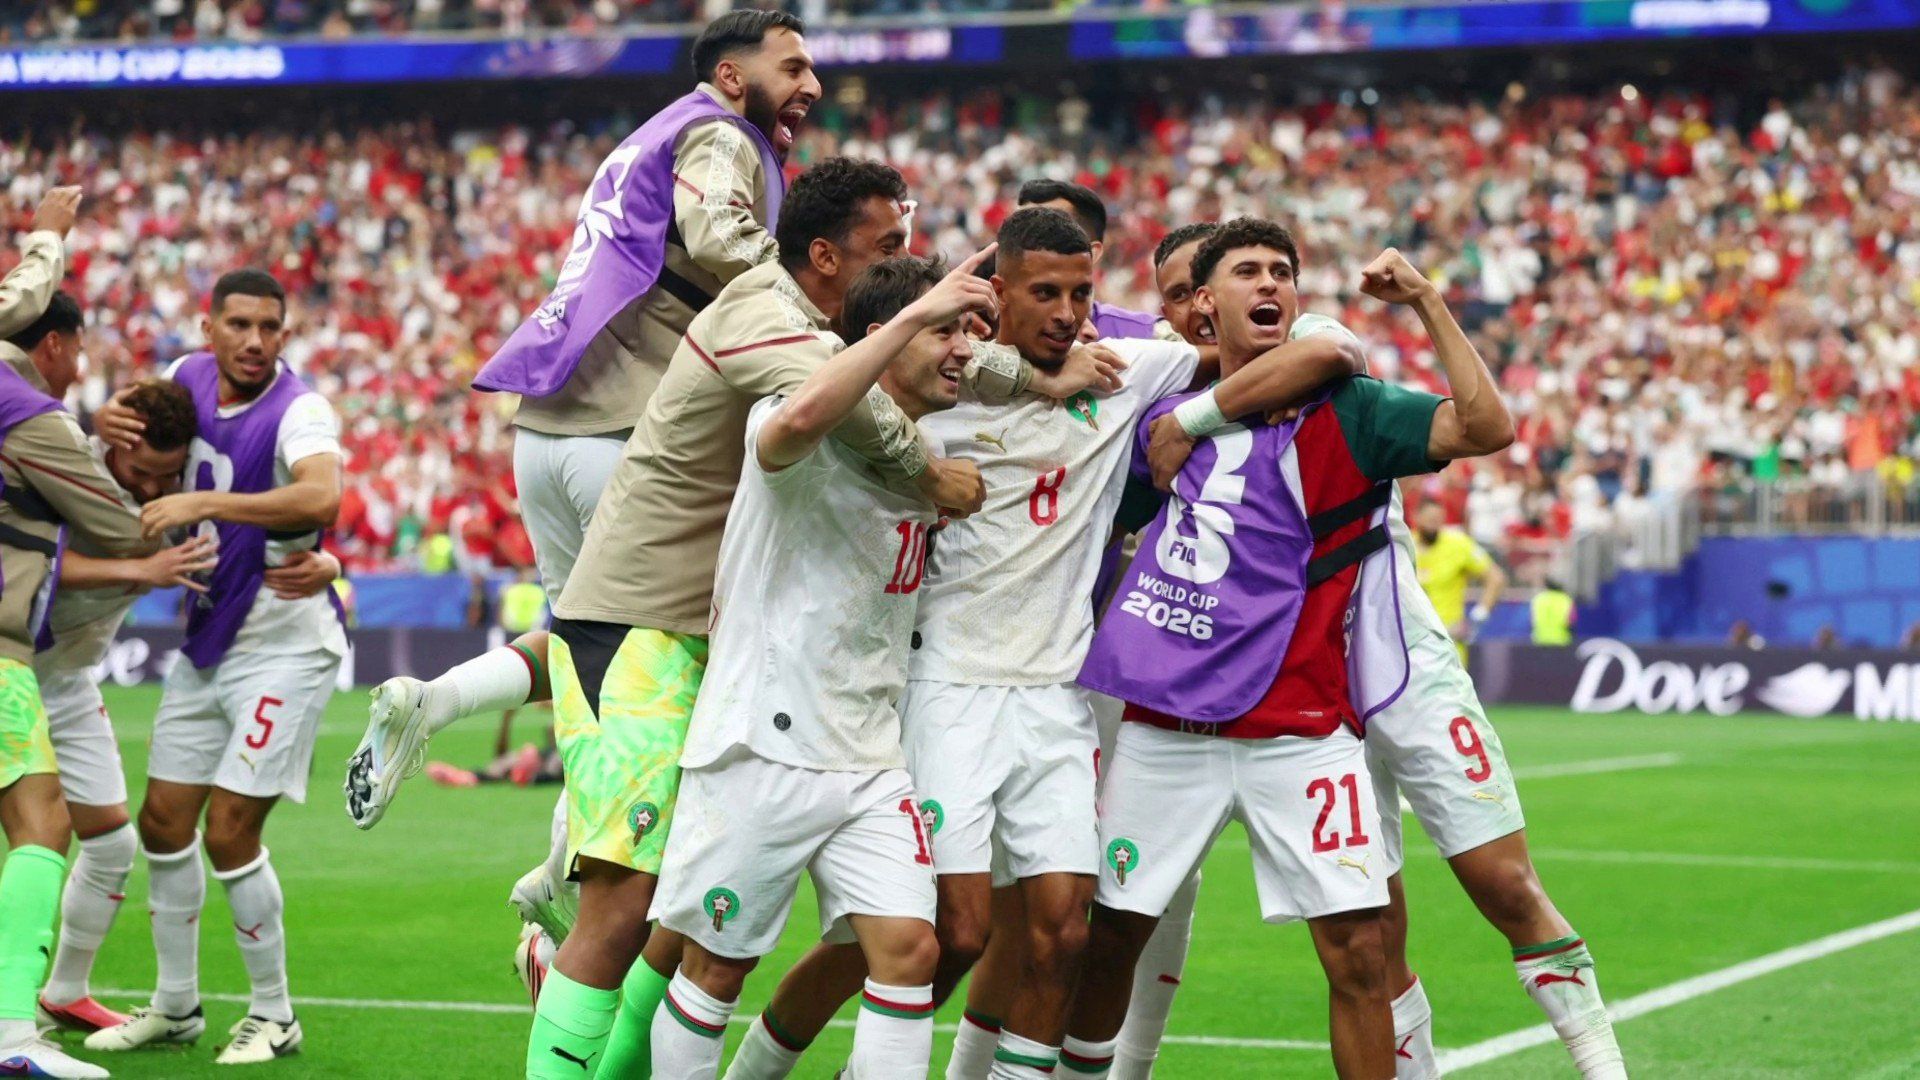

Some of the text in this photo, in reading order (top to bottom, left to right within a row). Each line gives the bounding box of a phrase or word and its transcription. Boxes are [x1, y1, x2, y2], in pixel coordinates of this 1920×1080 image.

[20, 50, 119, 84] WORLD
[123, 49, 181, 81] CUP
[181, 46, 285, 80] 2026
[1029, 464, 1067, 526] 8
[883, 520, 927, 594] 10
[1120, 591, 1213, 640] 2026
[1137, 571, 1219, 611] WORLD CUP
[1570, 637, 1750, 716] Dove
[245, 695, 284, 751] 5
[1448, 715, 1493, 783] 9
[898, 798, 932, 866] 1
[1306, 773, 1370, 853] 21
